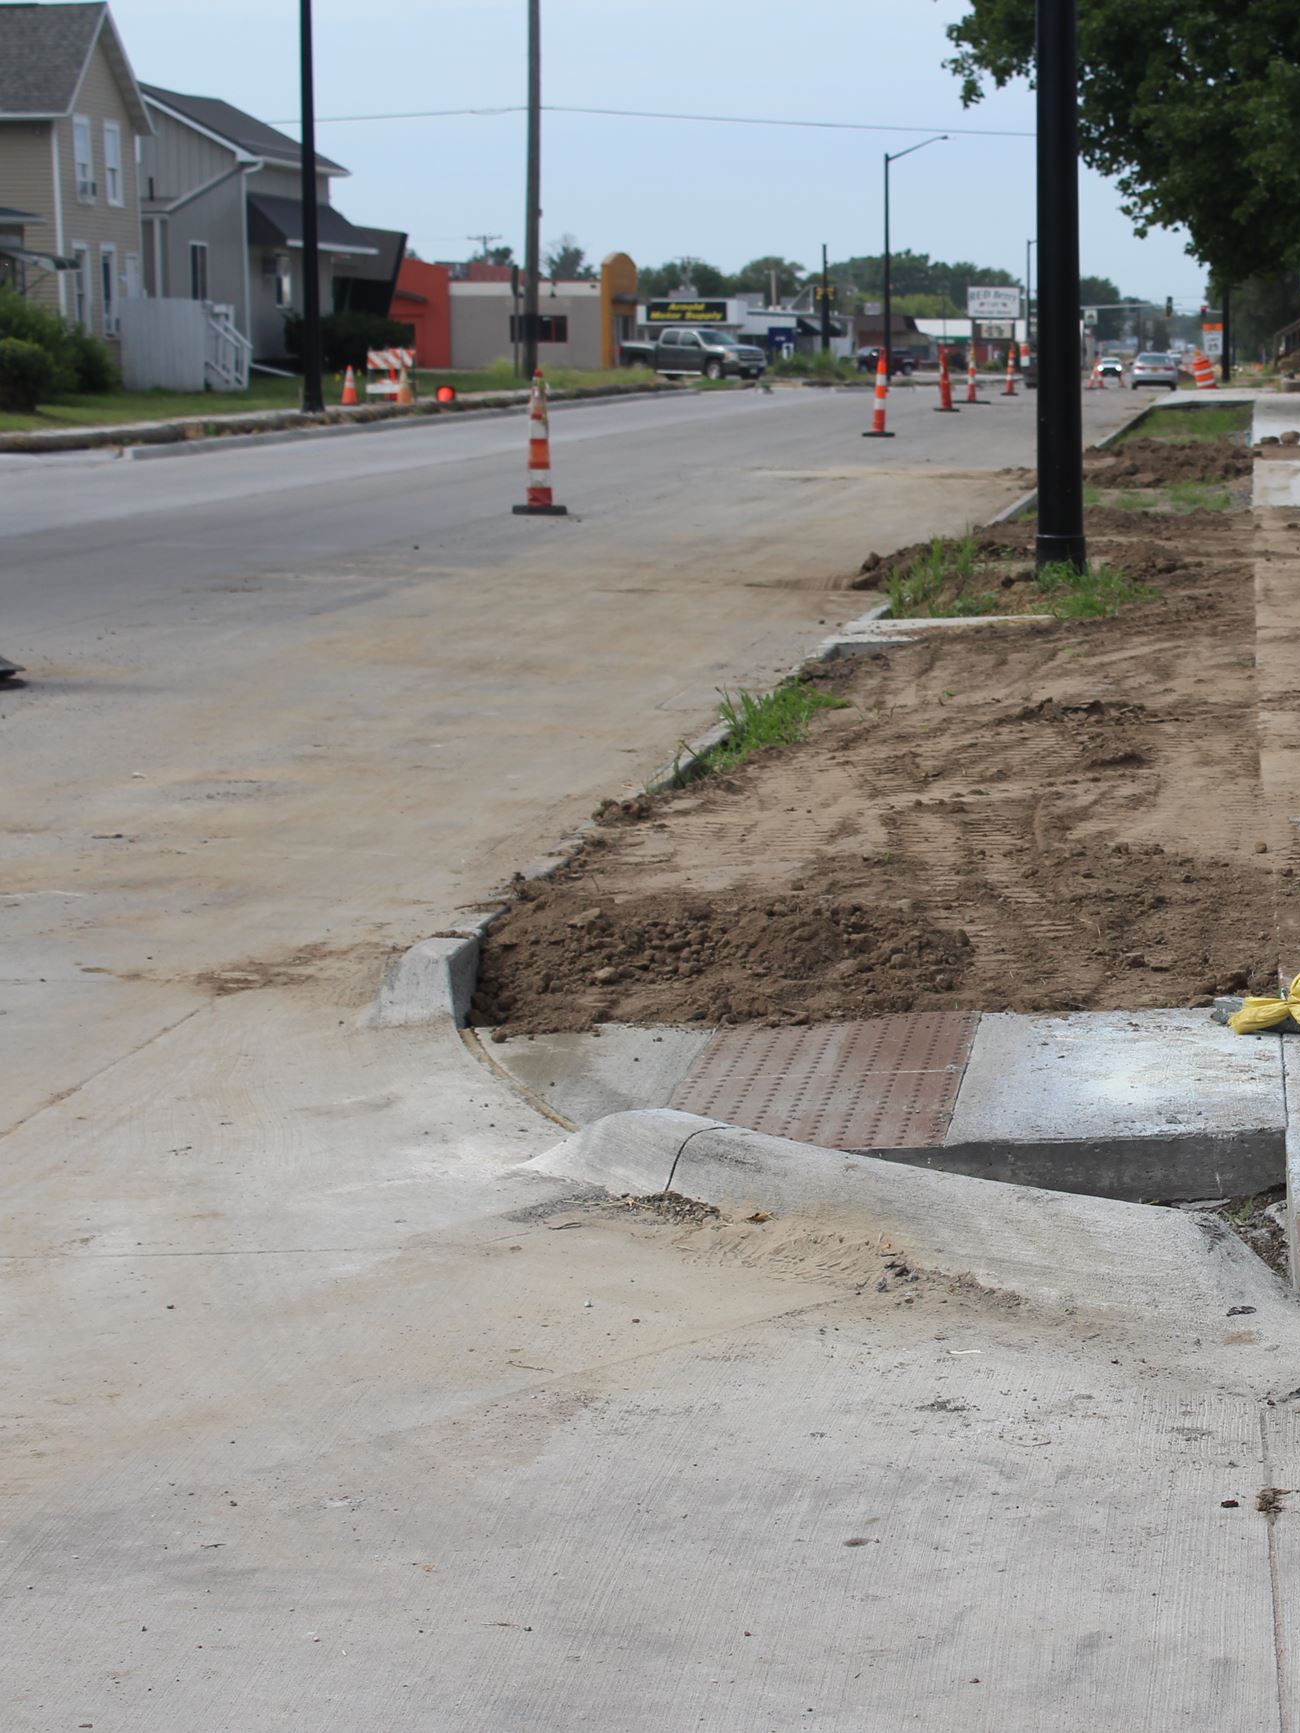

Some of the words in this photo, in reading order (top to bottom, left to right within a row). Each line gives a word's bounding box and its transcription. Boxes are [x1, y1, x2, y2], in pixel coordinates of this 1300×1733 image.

[668, 303, 705, 311] Arnold
[650, 311, 682, 320] Motor
[684, 311, 723, 321] Supply
